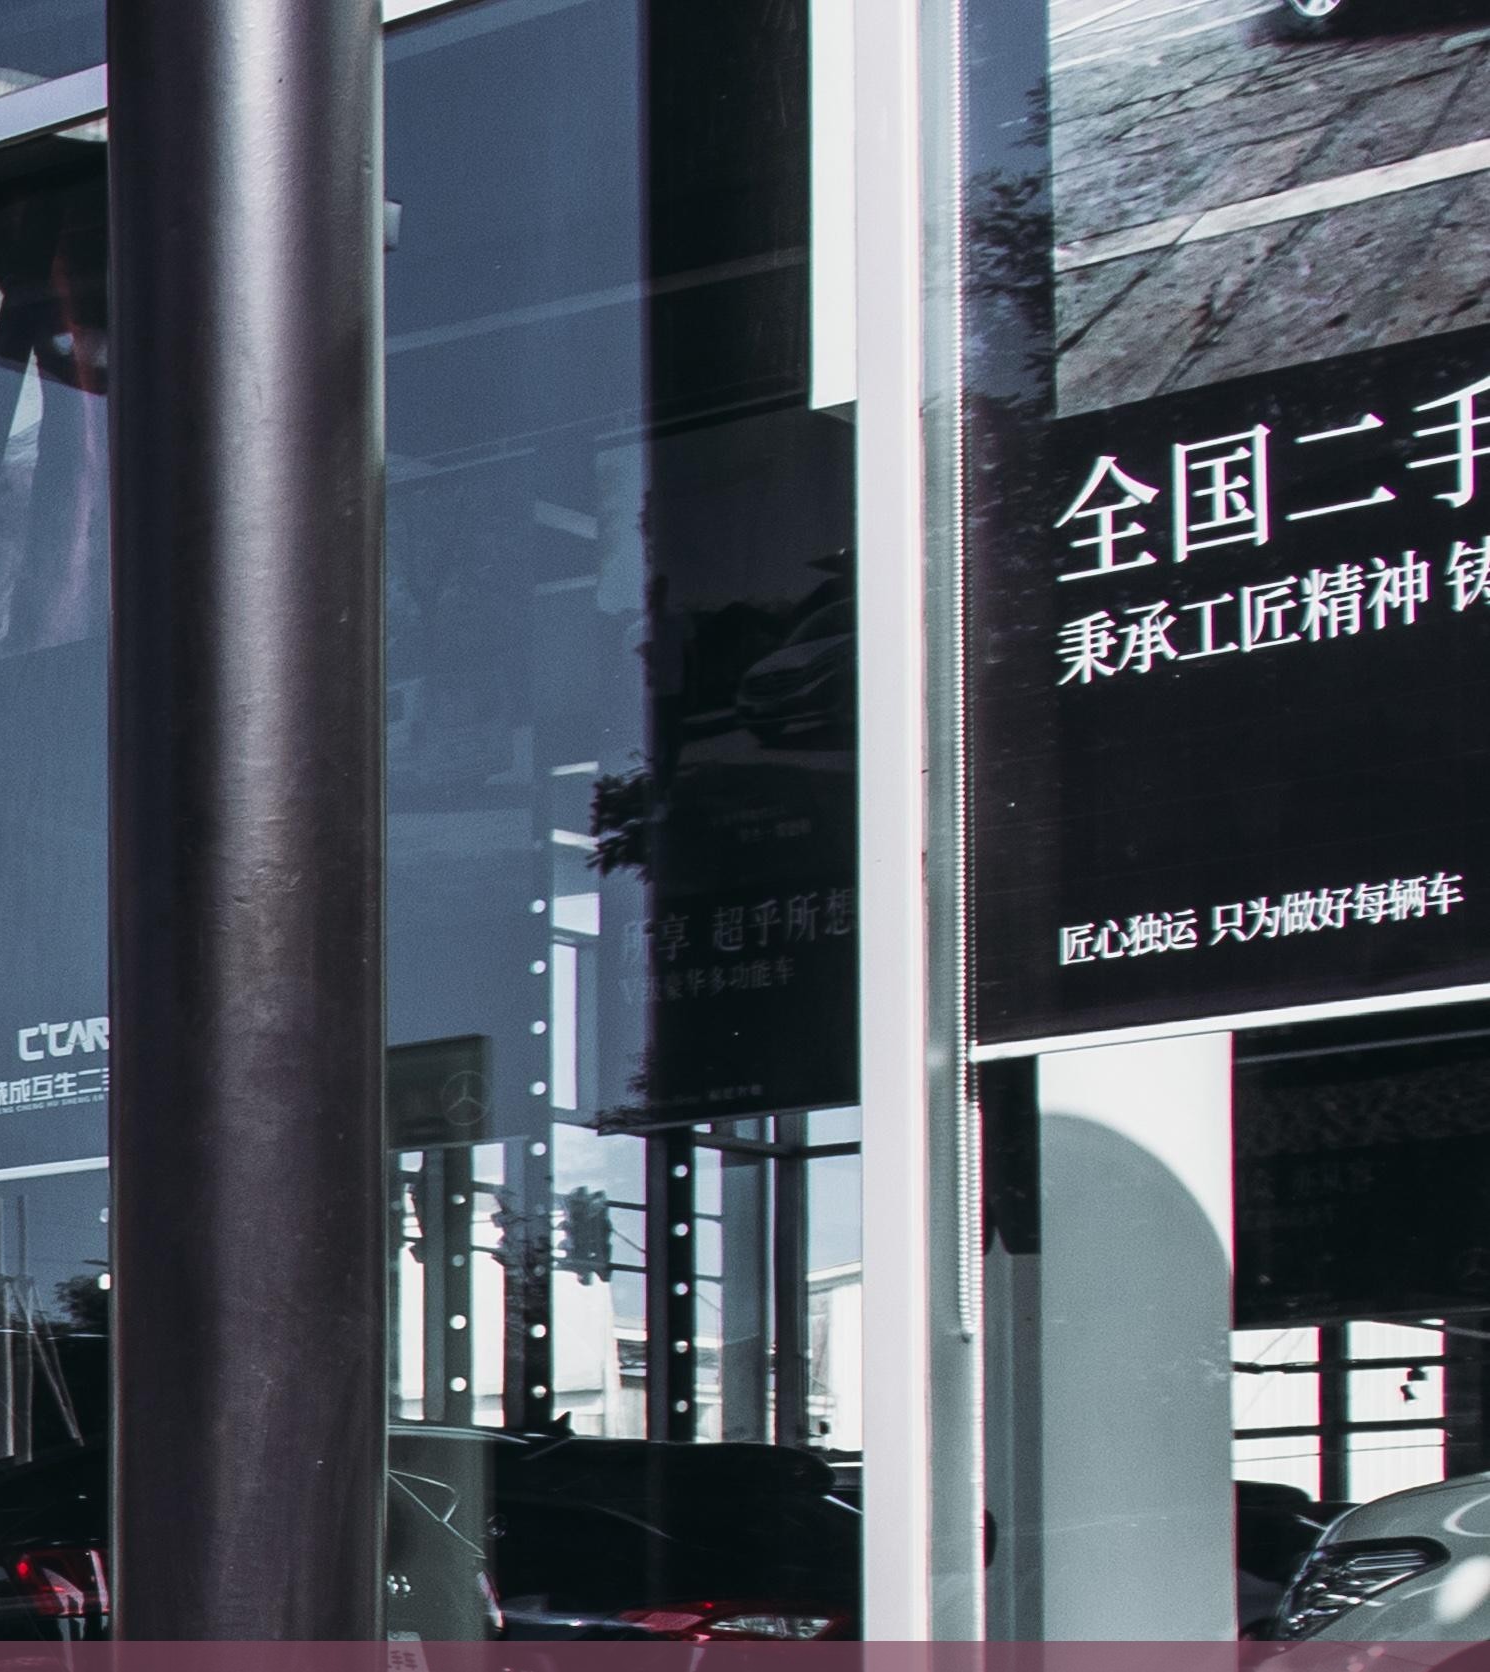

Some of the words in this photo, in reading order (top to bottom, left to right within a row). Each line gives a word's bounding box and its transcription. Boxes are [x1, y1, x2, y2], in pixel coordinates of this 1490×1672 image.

[1053, 374, 1490, 584] 全国二手
[1055, 550, 1431, 686] 秉承工匠精神
[1058, 907, 1199, 966] 匠心独运
[1207, 871, 1465, 947] 只为做好每辆车
